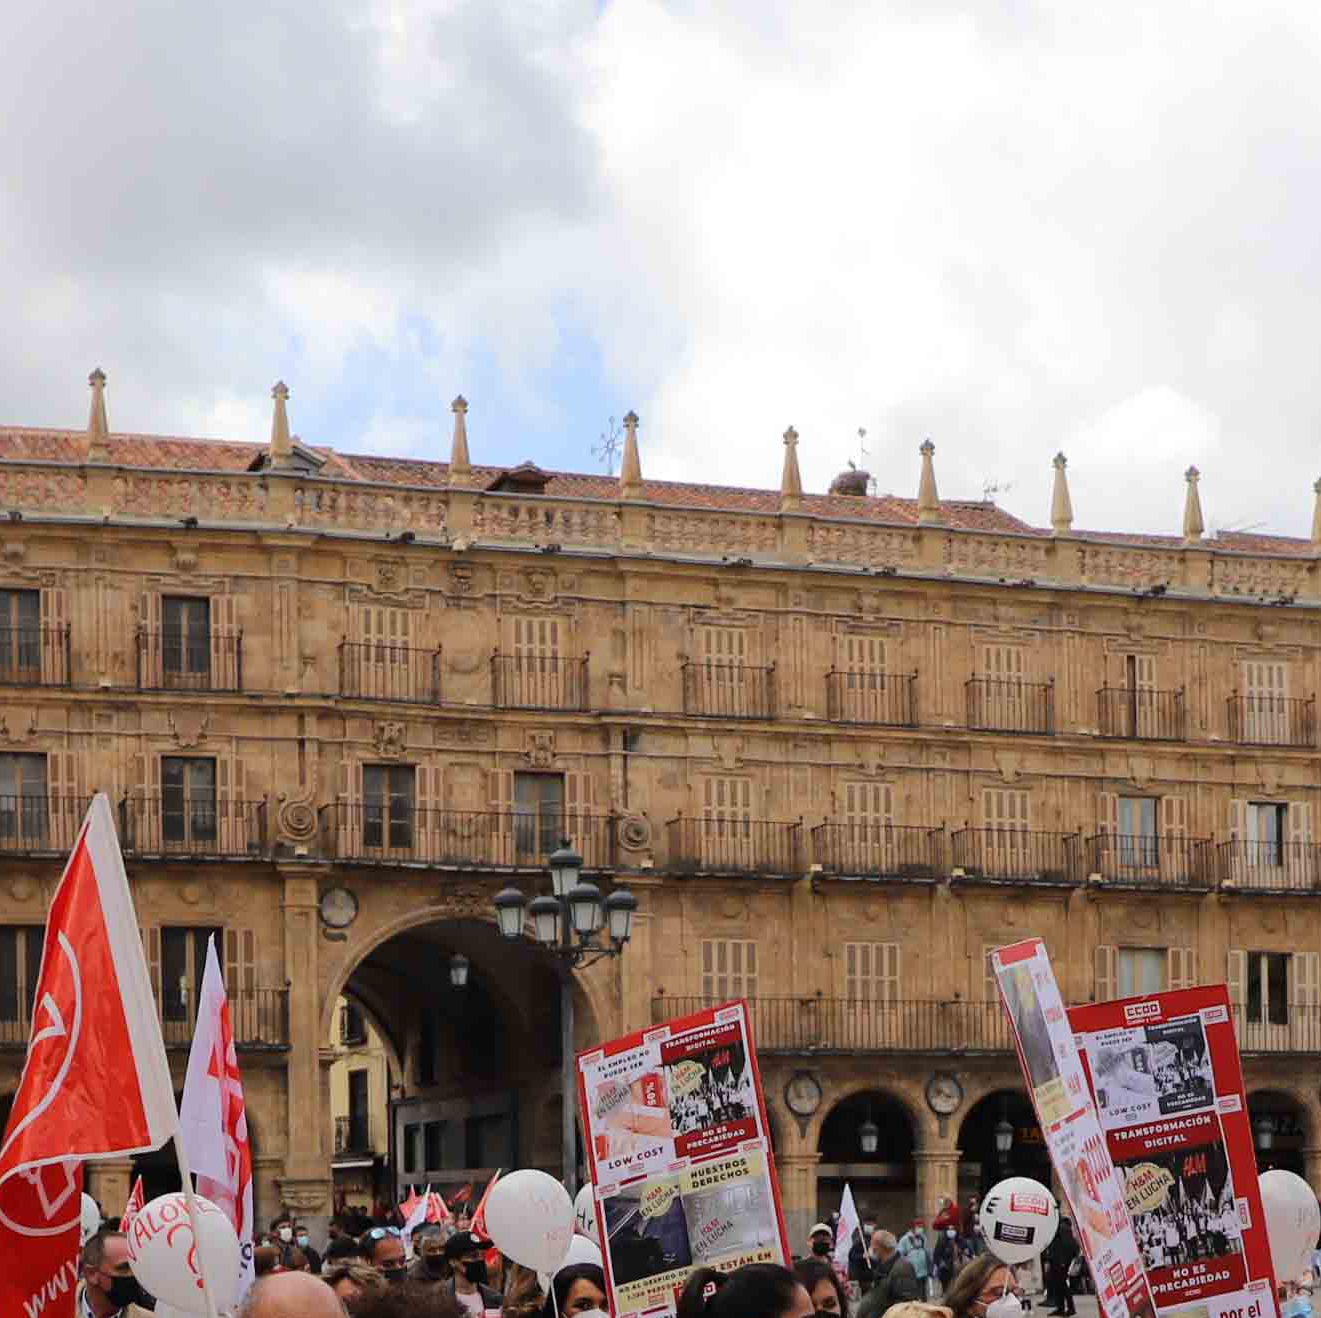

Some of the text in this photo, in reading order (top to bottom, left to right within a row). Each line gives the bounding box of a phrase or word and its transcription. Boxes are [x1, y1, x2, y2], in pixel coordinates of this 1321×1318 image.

[1126, 1003, 1159, 1017] CCOO
[665, 1023, 736, 1050] TRANSFORMACIÓN
[685, 1038, 717, 1052] DIGITAL
[608, 1052, 638, 1069] EMPLEO
[1109, 1102, 1152, 1117] LOW COST
[686, 1128, 746, 1150] PRECARIEDAD
[702, 1126, 728, 1138] NO ES
[1113, 1114, 1212, 1142] TRANSFORMACIÓN
[1143, 1134, 1188, 1149] DIGITAL
[608, 1155, 633, 1170] LOW
[637, 1146, 665, 1161] COST
[690, 1157, 747, 1180] NUESTROS
[692, 1167, 751, 1190] DERECHOS
[1130, 1169, 1155, 1191] H&M
[645, 1185, 664, 1201] H&M
[1125, 1173, 1171, 1211] EN LUCHA
[641, 1204, 653, 1218] EN
[652, 1189, 676, 1212] LUCHA
[707, 1220, 734, 1247] LUCHA
[1173, 1263, 1207, 1278] NO ES
[1151, 1270, 1231, 1296] PRECARIEDAD
[1248, 1299, 1262, 1318] el
